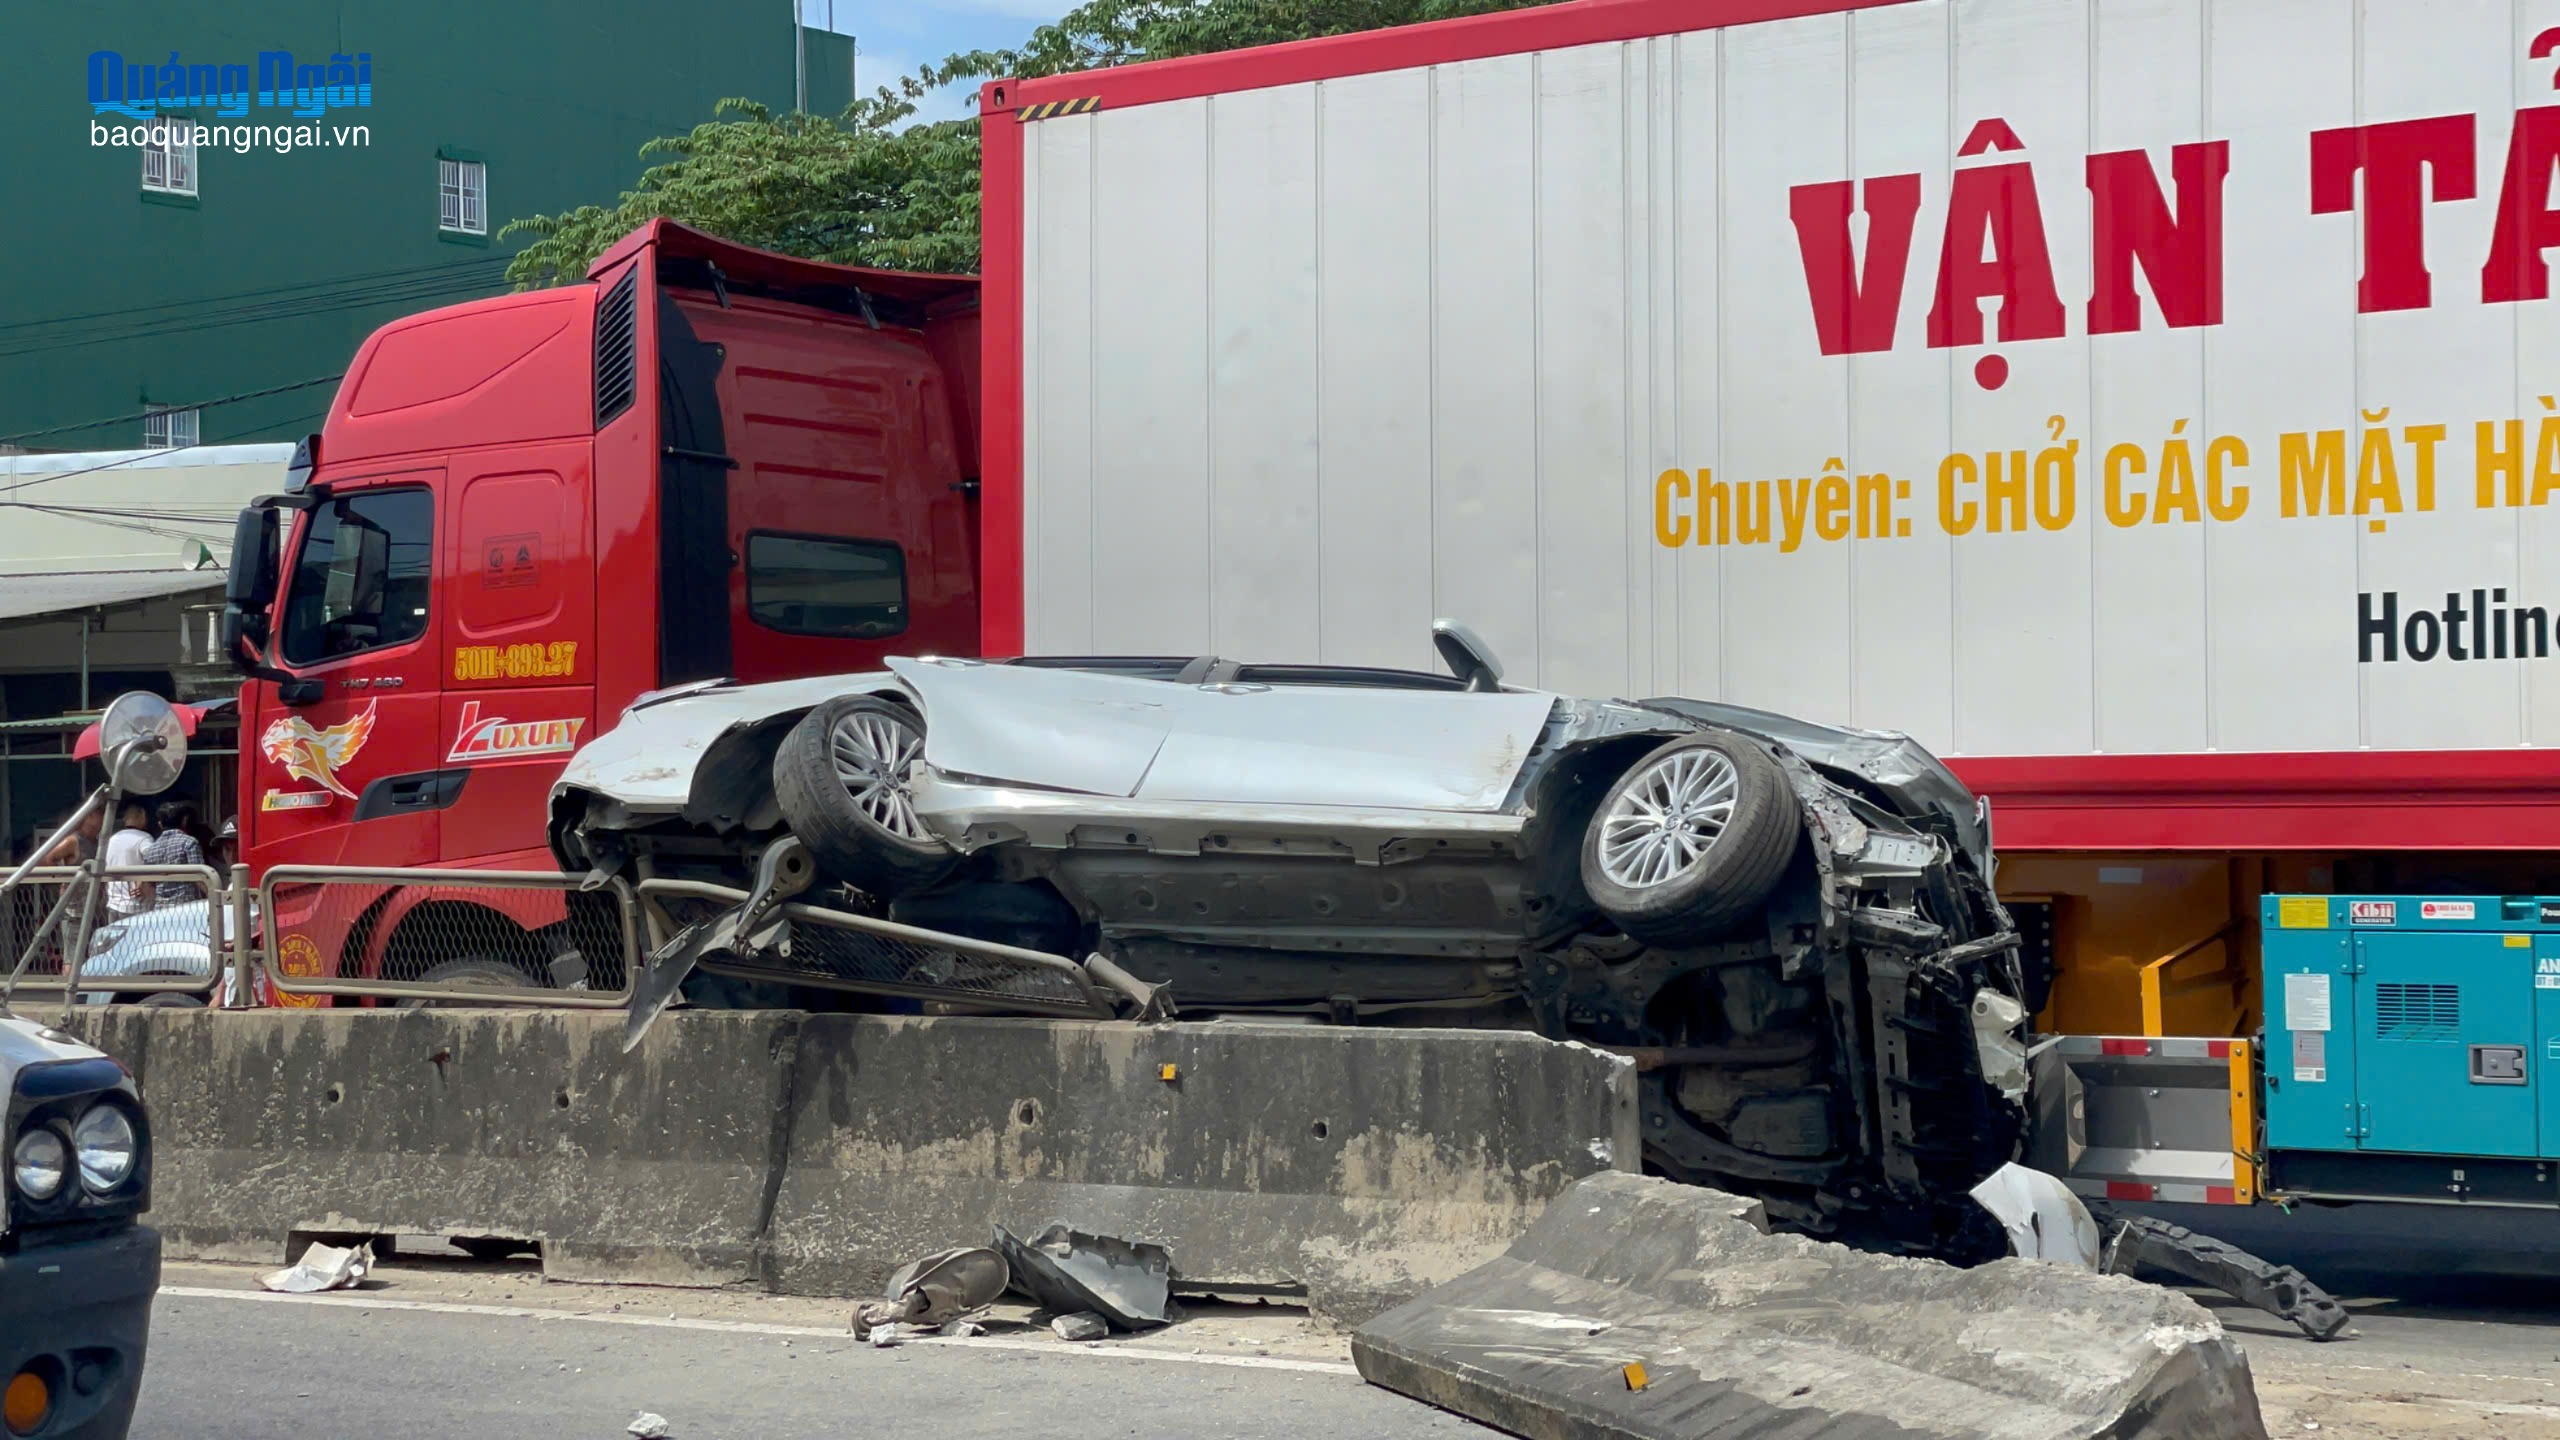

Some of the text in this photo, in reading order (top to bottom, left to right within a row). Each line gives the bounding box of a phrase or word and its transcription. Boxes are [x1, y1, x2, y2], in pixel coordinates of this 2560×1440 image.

[1790, 118, 2229, 391] VẬN
[1655, 457, 1911, 554] Chuyên:
[1938, 415, 2080, 536] CHỞ
[2104, 419, 2250, 528] CÁC
[2279, 407, 2446, 533] MẶT
[2357, 587, 2560, 663] Hotlin
[449, 700, 583, 756] LUXURY
[2352, 903, 2392, 917] Kibii
